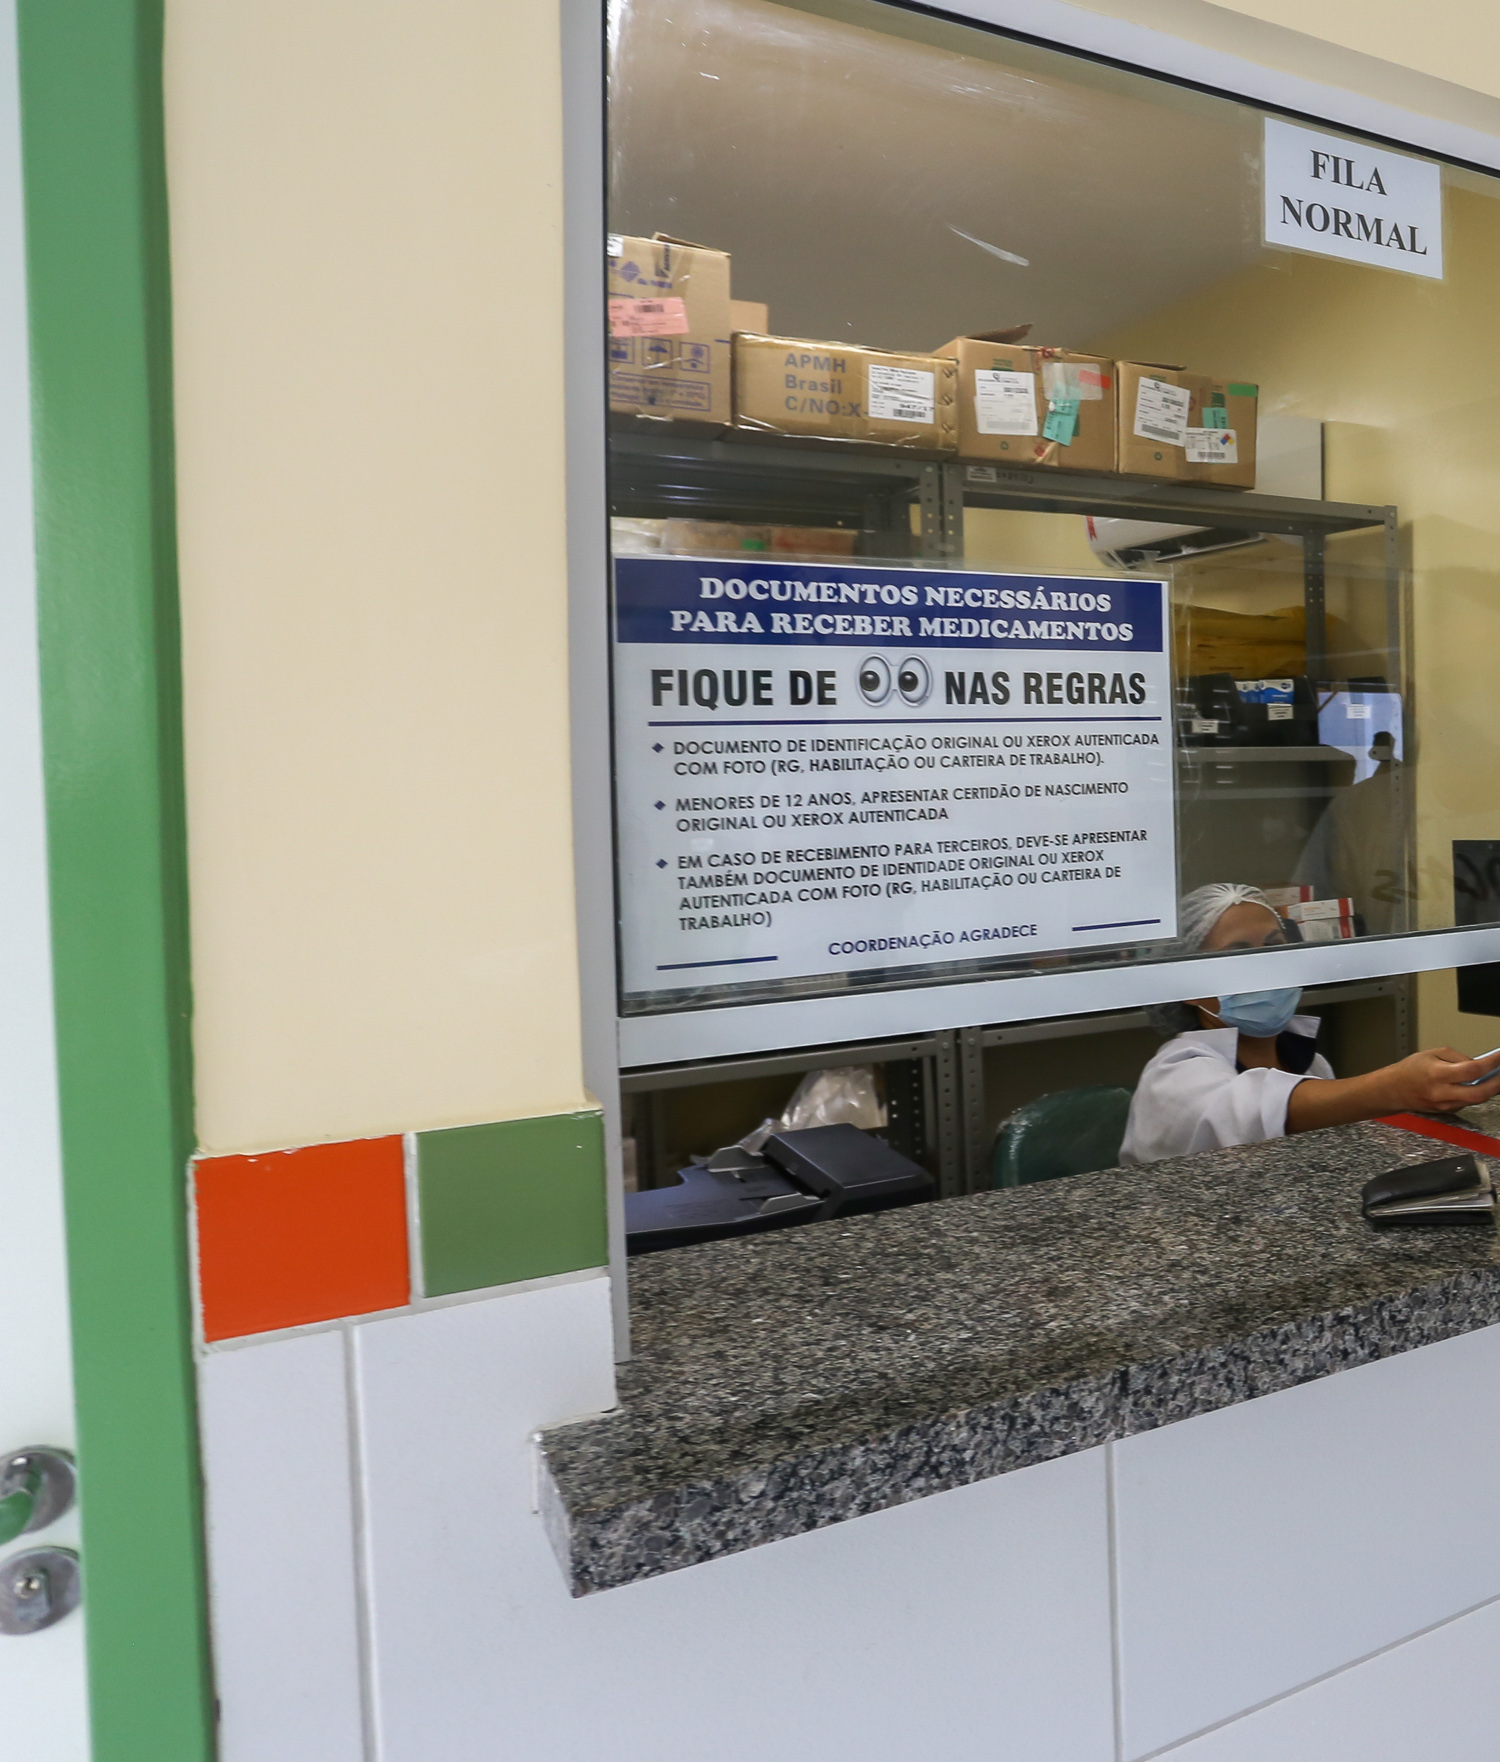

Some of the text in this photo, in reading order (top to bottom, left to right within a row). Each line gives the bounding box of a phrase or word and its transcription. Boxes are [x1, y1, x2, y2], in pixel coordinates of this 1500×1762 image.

[1309, 149, 1388, 196] FILA
[1280, 194, 1427, 255] NORMAL
[784, 352, 846, 374] APMH
[785, 374, 843, 394] Brasil
[699, 577, 1111, 612] DOCUMENTOS NECESSÁRIOS
[670, 610, 1133, 641] PARA RECEBER MEDICAMENTOS
[651, 668, 1146, 710] FIQUE DE NAS REGRAS
[674, 733, 1159, 754] DOCUMENTO DE IDENTIFICAÇÃO ORIGINAL OU XEROX AUTENTICADA
[674, 751, 1104, 776] COM FOTO (RG, HABILITAÇÃO OU CARTEIRA DE TRABALHO).
[676, 781, 1128, 811] MENORES DE 12 ANOS, APRESENTAR CERTIDÃO DE NASCIMENTO
[676, 807, 948, 832] ORIGINAL OU XEROX AUTENTICADA
[678, 829, 1147, 869] EM CASO DE RECEBIMENTO PARA TERCEIROS, DEVE-SE APRESENTAR
[678, 849, 1104, 889] TAMBÉM DOCUMENTO DE IDENTIDADE ORIGINAL OU XEROX
[679, 865, 1120, 910] AUTENTICADA COM FOTO (RG, HABILITAÇÃO OU CARTEIRA DE
[679, 910, 771, 930] TRABALHO)
[828, 923, 1037, 955] COORDENAÇÃO AGRADECE
